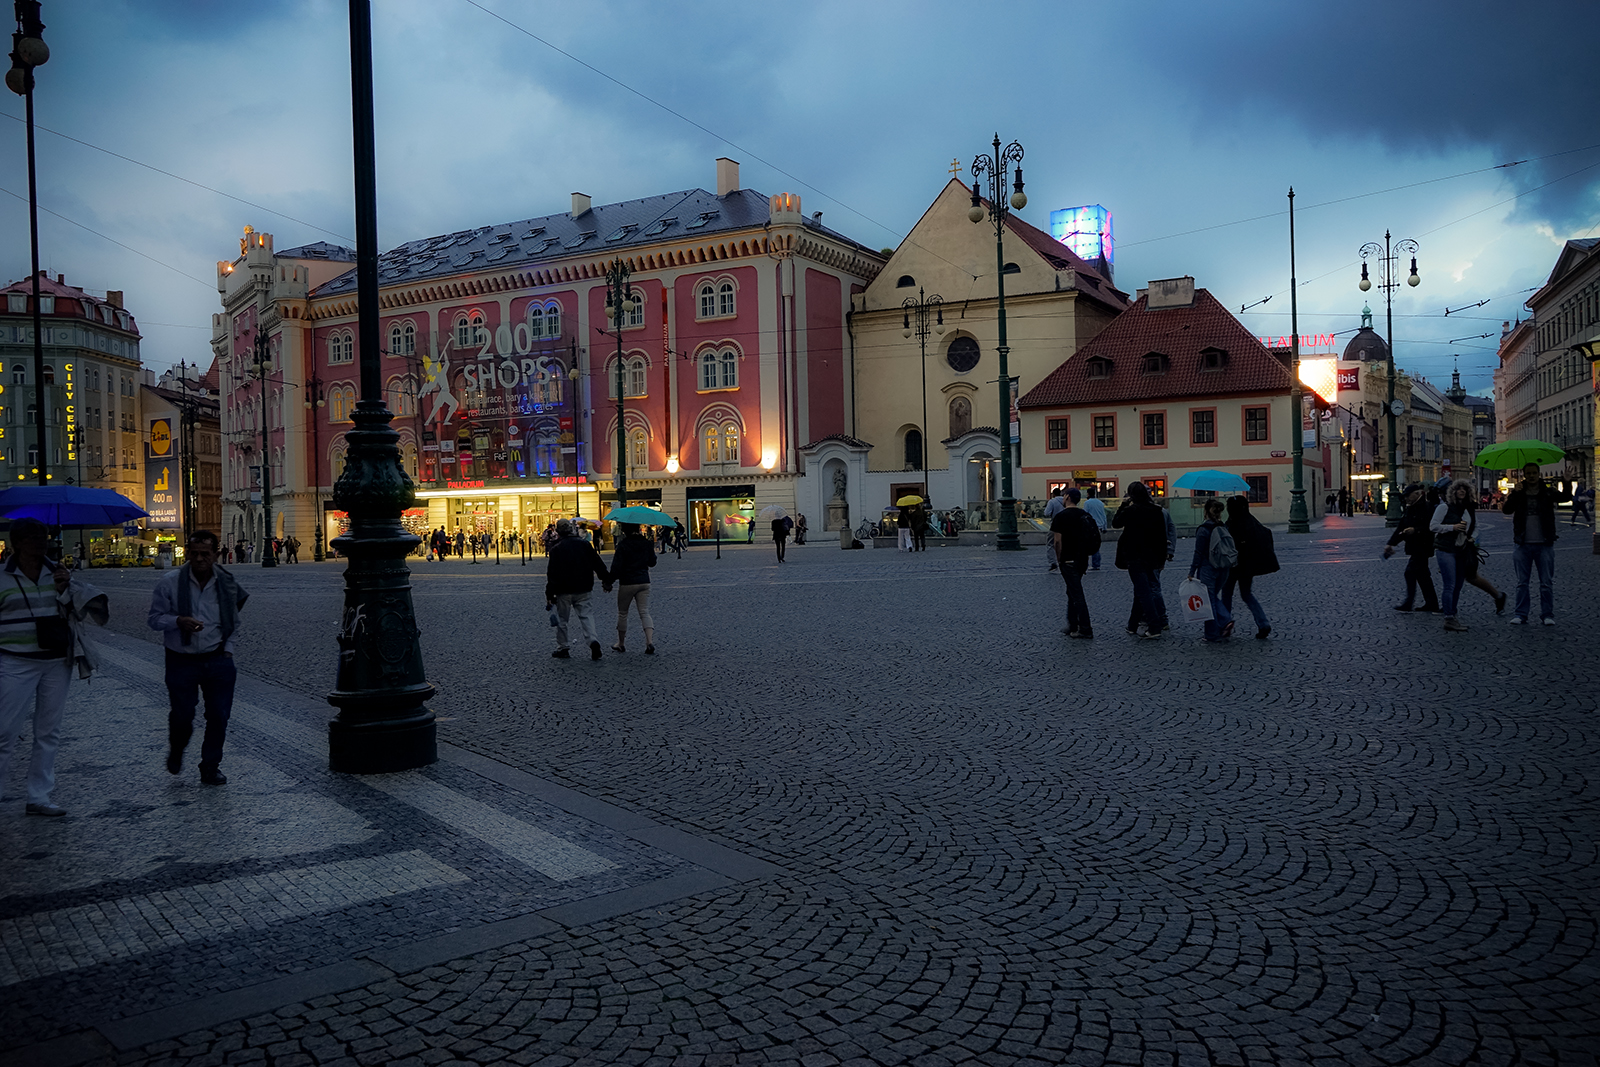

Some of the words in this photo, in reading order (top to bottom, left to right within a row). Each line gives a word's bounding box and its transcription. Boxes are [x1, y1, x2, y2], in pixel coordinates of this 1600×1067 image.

[475, 323, 532, 361] 200
[463, 356, 551, 392] SHOPS
[1338, 373, 1356, 384] ibis
[64, 363, 74, 400] CITY
[526, 403, 533, 411] &
[447, 480, 484, 488] PALLADIUM
[153, 494, 165, 503] 400
